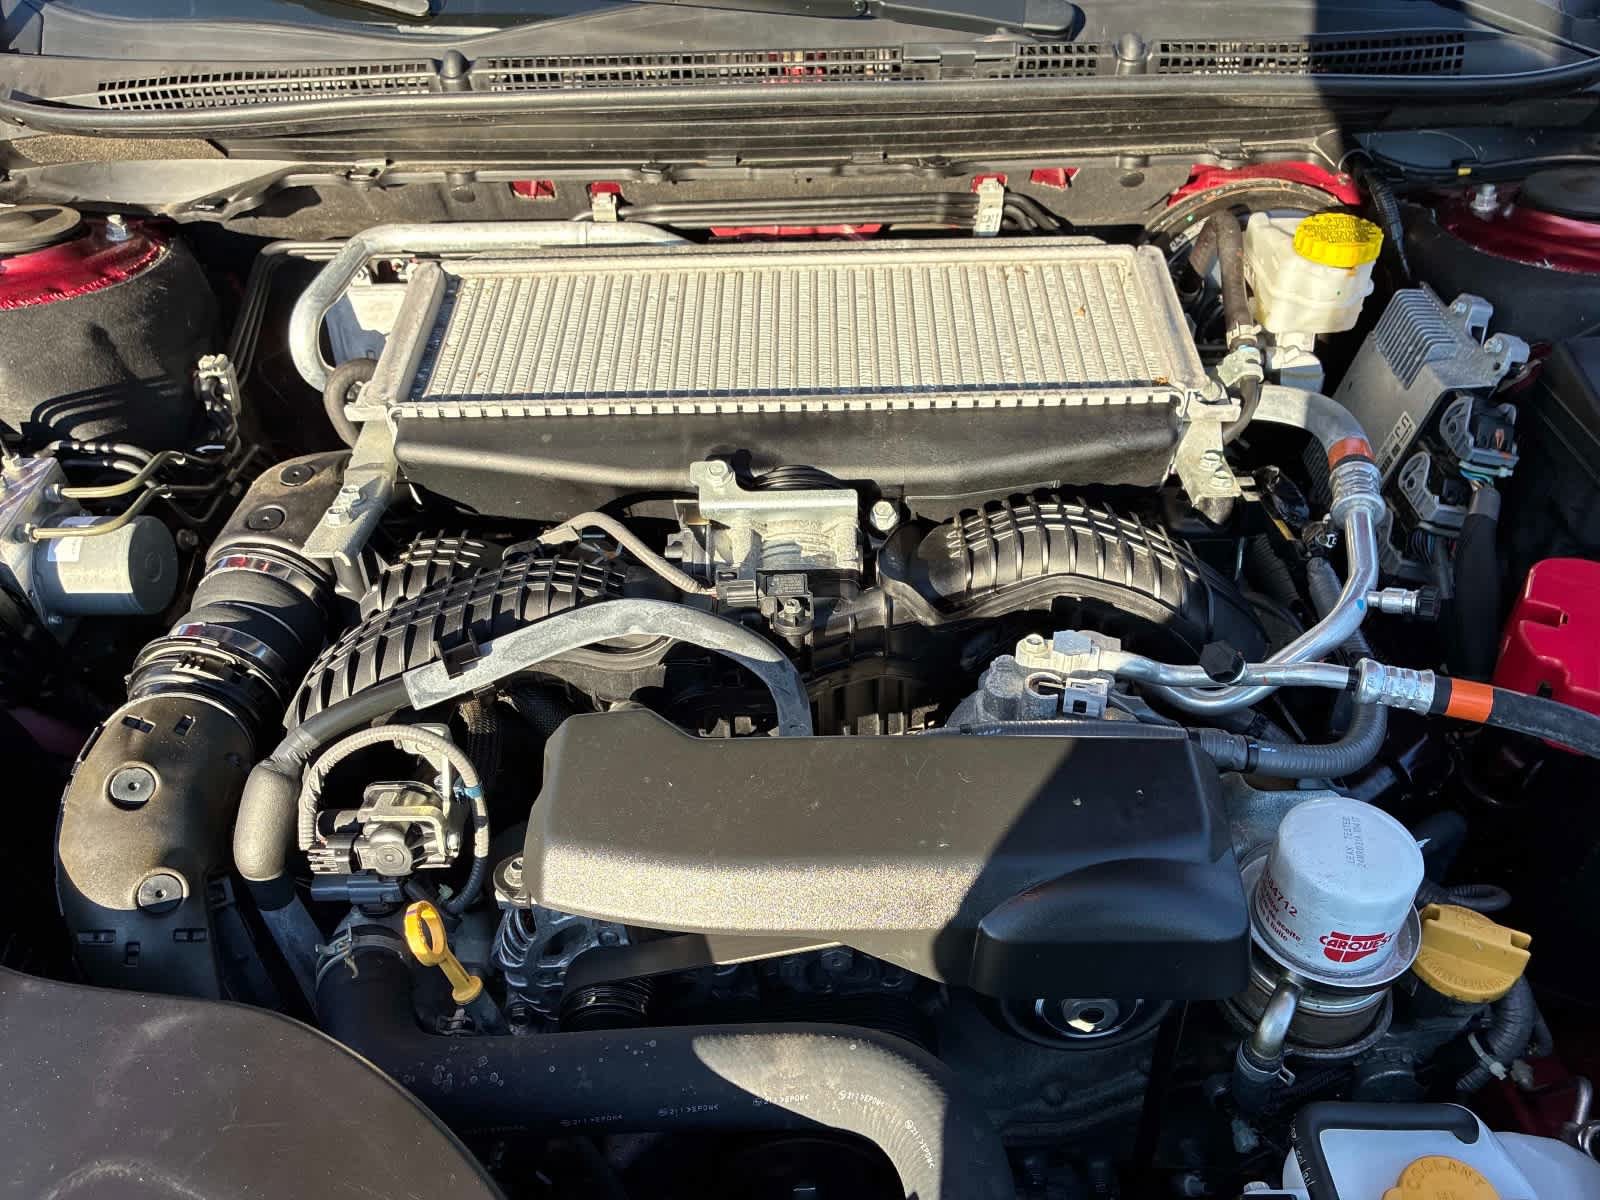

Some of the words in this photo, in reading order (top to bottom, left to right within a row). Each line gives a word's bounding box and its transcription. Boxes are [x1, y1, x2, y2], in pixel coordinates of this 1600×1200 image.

[1276, 920, 1302, 942] aceite
[1319, 931, 1395, 951] CARQUEST
[1406, 1158, 1487, 1191] COOLANT
